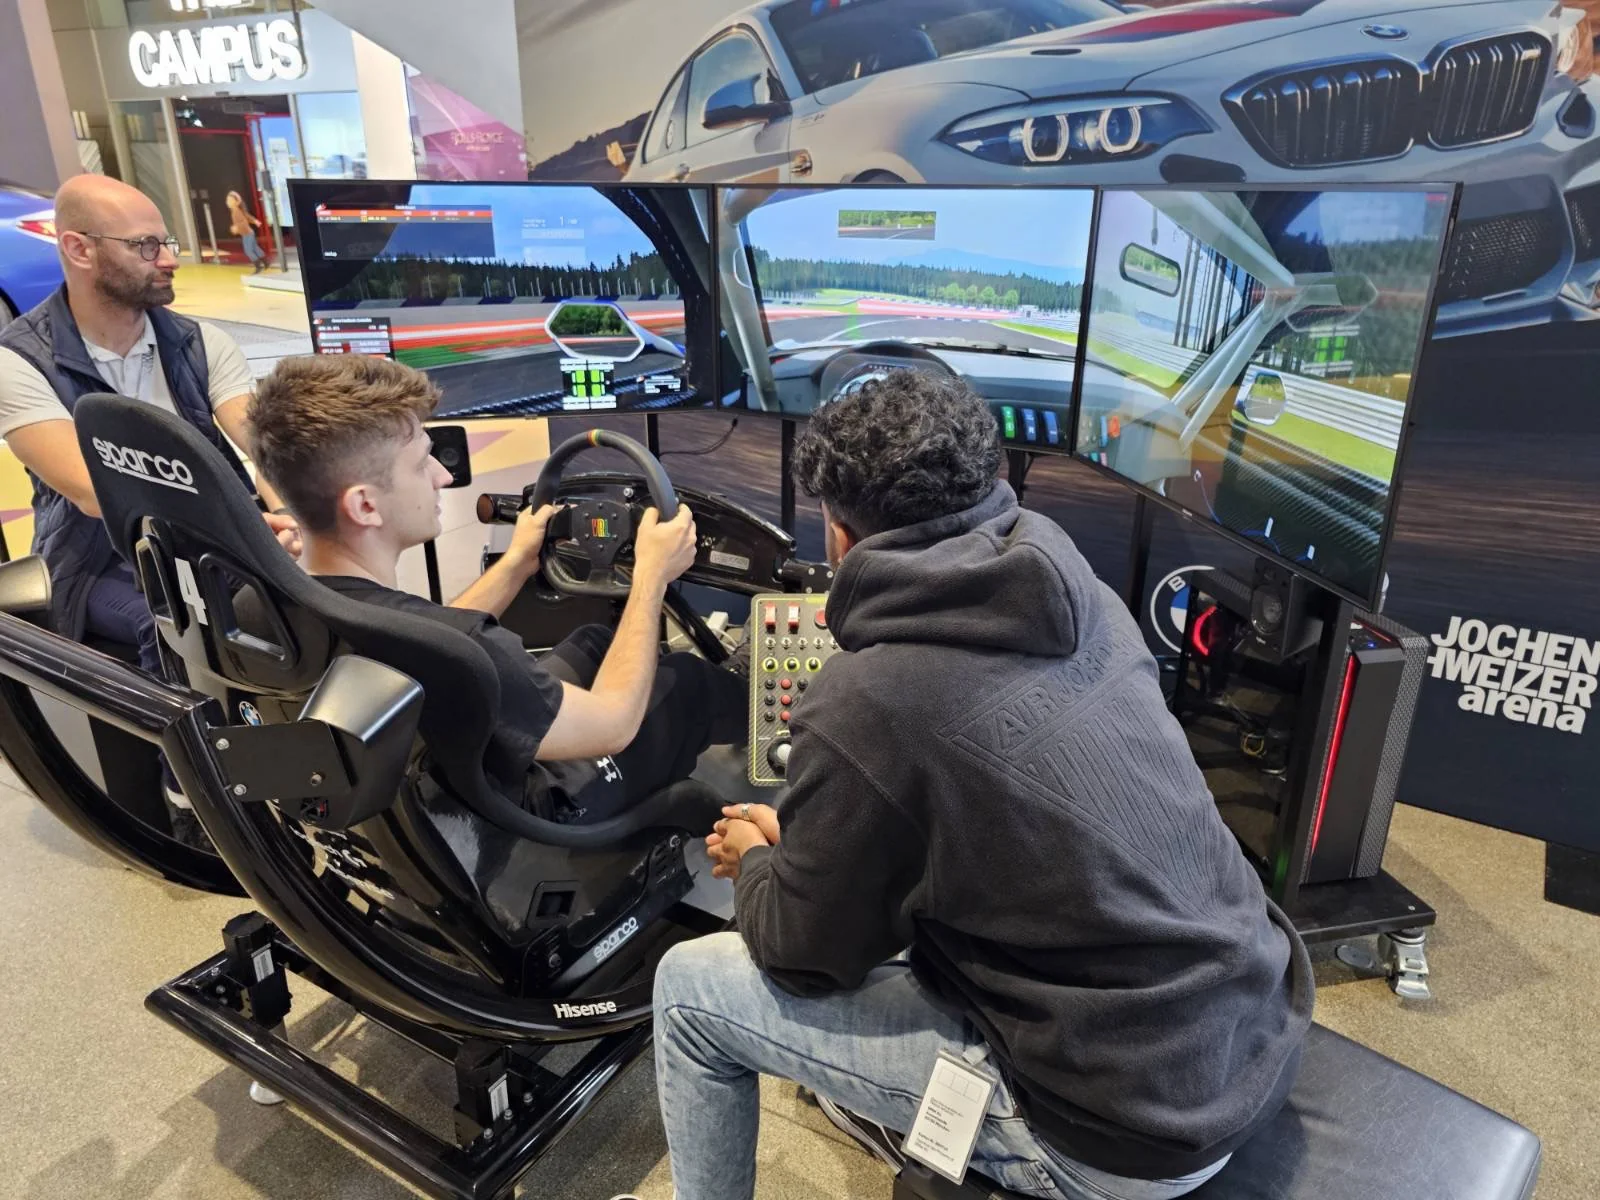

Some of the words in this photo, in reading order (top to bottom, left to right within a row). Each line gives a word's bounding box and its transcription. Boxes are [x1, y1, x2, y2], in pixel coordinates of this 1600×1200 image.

[129, 19, 304, 88] CAMPUS
[92, 436, 195, 486] sparco
[1430, 615, 1600, 675] JOCHEN
[1426, 646, 1598, 709] HWEIZER
[993, 686, 1060, 752] AIR
[1457, 684, 1587, 735] arena
[553, 1001, 617, 1019] Hisense
